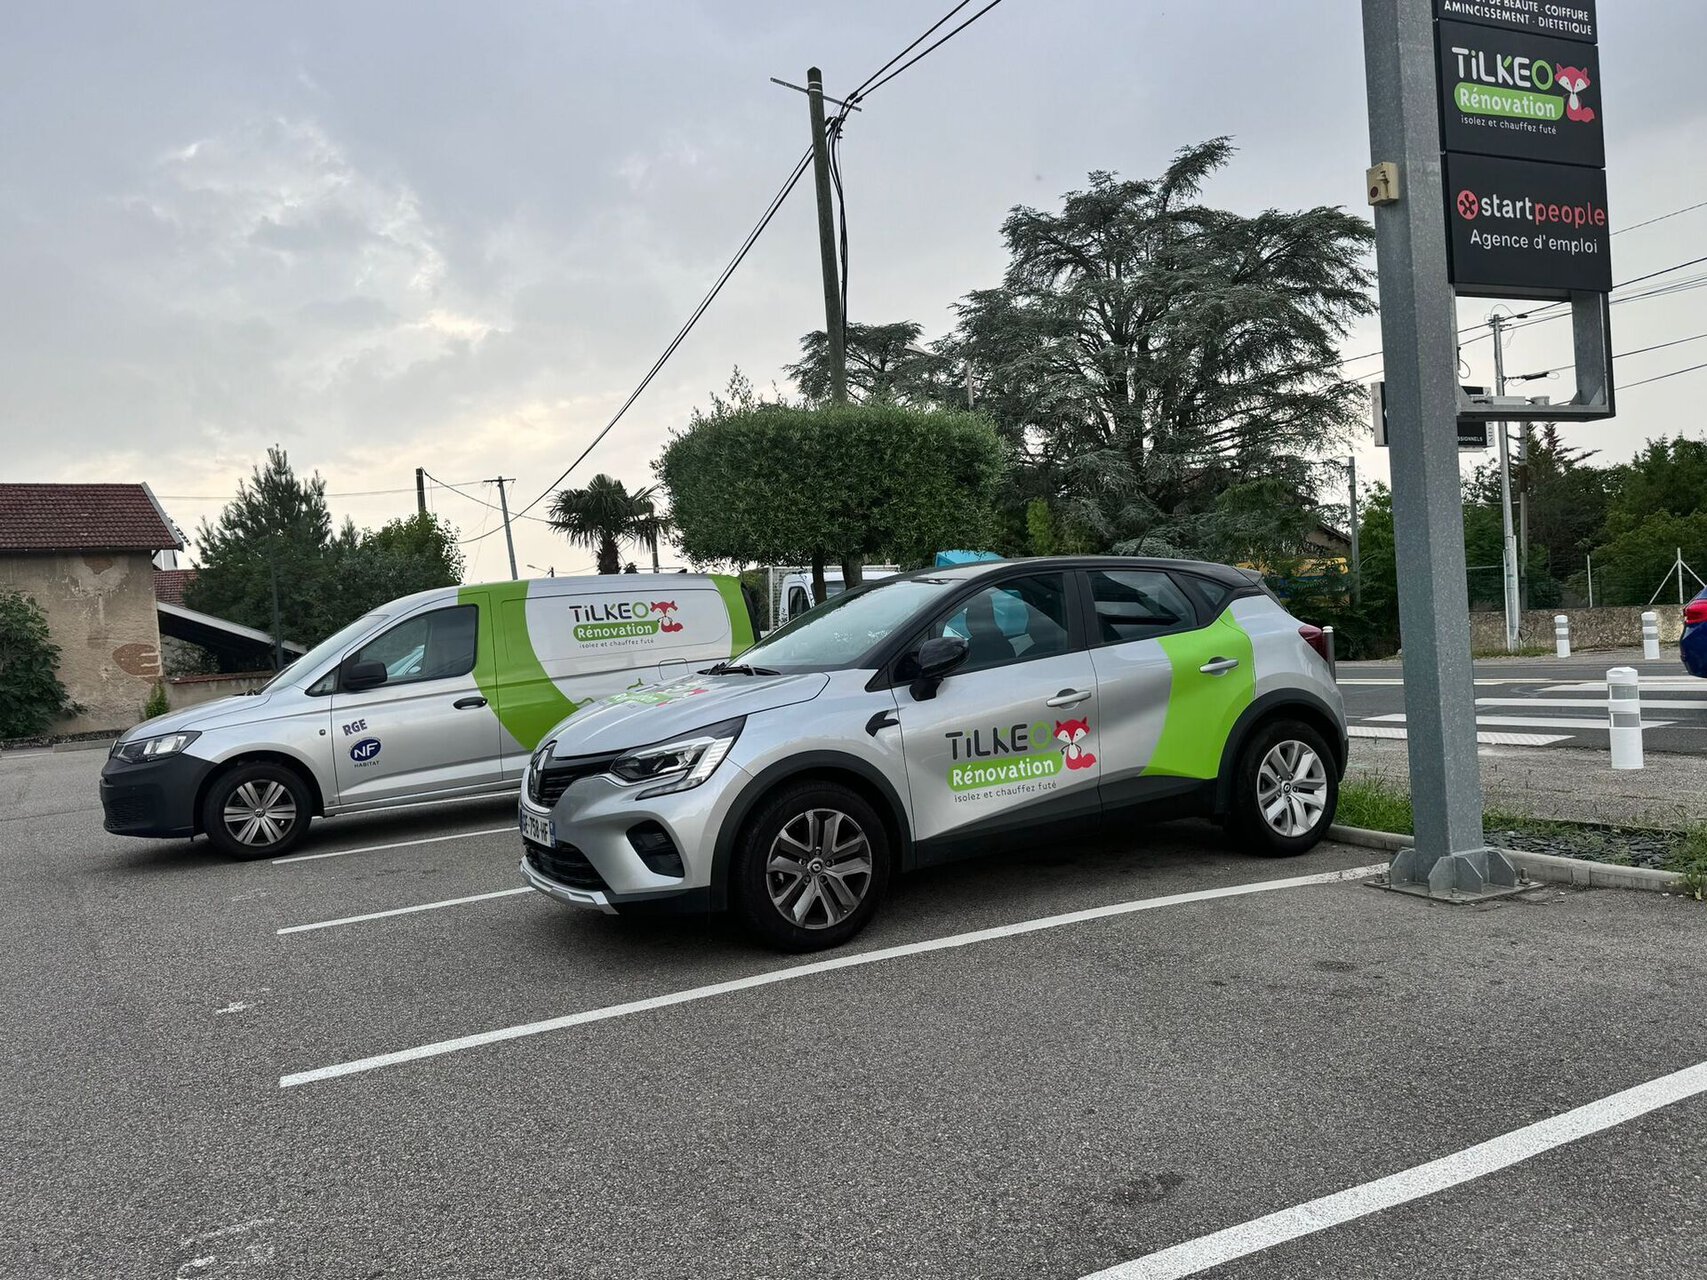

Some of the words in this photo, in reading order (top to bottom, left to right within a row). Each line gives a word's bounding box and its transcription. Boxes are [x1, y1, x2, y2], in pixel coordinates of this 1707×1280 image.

[1444, 2, 1530, 24] AMINCISSEMENT
[1538, 16, 1592, 35] DIETETIQUE
[1503, 0, 1539, 12] BEAUTE
[1545, 4, 1589, 22] COIFFURE
[1460, 86, 1556, 118] Rénovation
[1460, 114, 1486, 127] isolez
[1488, 119, 1498, 128] et
[1499, 120, 1537, 133] chauffez
[1539, 124, 1557, 135] futé
[1481, 193, 1606, 229] startpeople
[1470, 228, 1529, 250] Agence
[1533, 234, 1598, 255] d'emploi
[576, 622, 653, 640] Rénovation
[579, 641, 599, 649] isolez
[342, 718, 368, 736] RGE
[353, 742, 379, 759] NF
[952, 758, 1055, 787] Rénovation
[954, 792, 981, 803] isolez
[995, 783, 1036, 797] chauffez
[1038, 780, 1057, 790] futé
